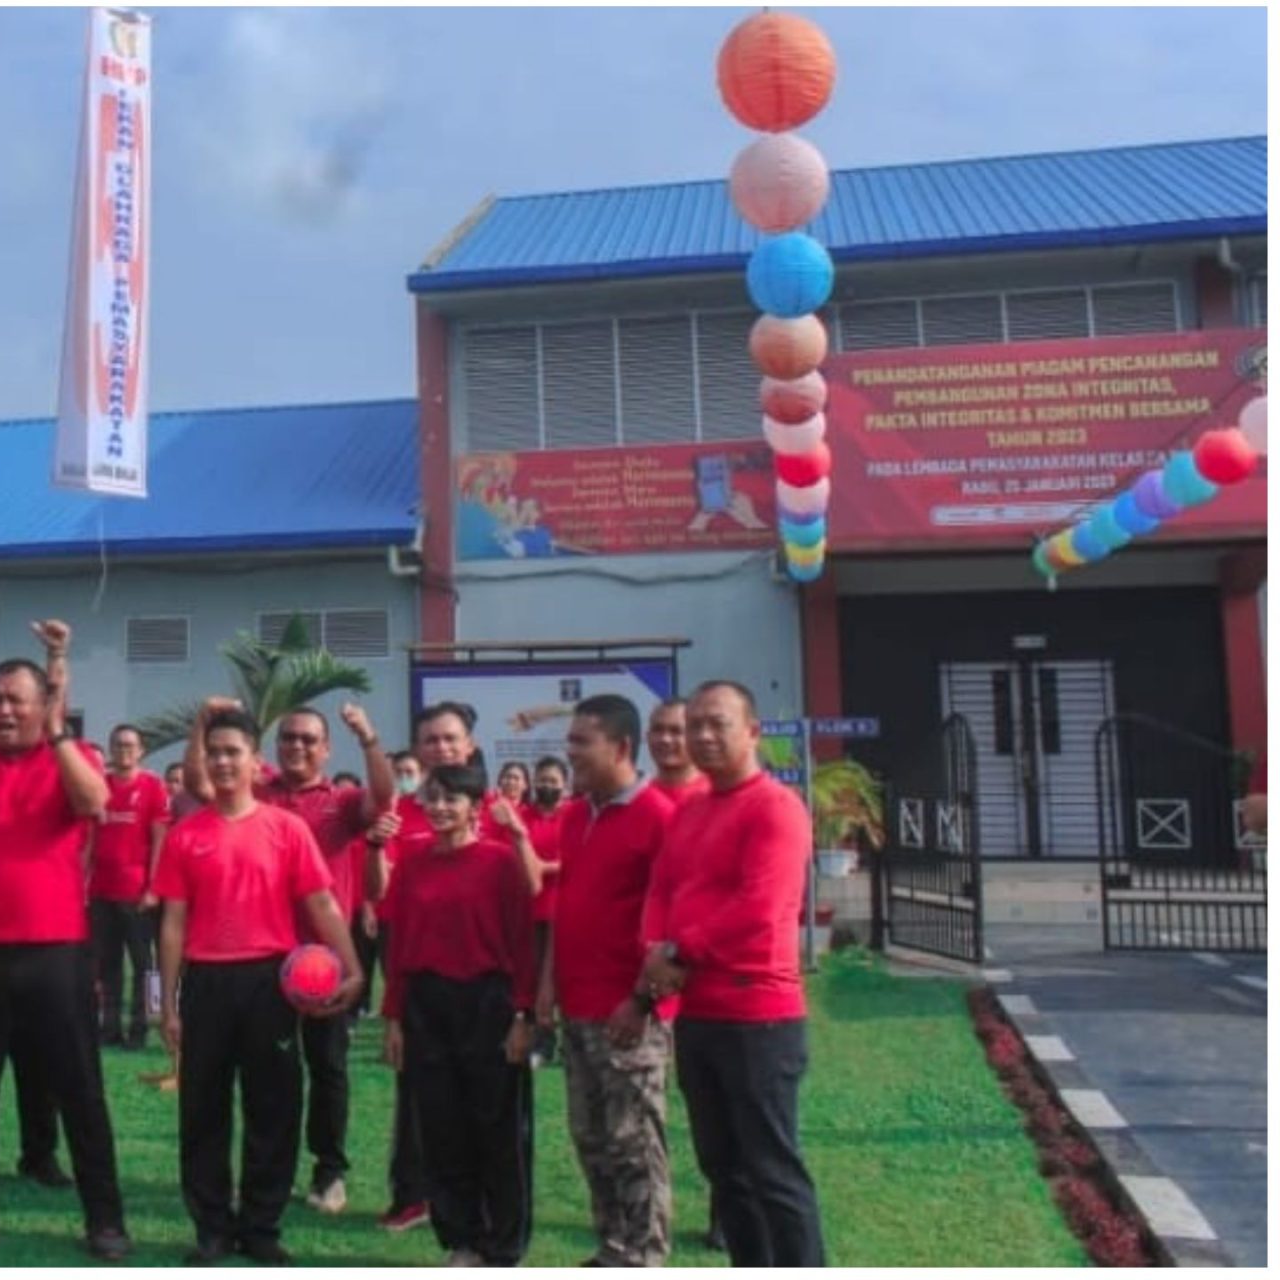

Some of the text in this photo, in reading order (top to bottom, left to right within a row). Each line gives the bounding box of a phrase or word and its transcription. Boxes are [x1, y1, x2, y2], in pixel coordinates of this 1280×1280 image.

[107, 277, 131, 458] PEMASYARAKATAN
[853, 350, 1219, 386] PENANDATANGANAN PIAGAM PENCANANGAN
[894, 376, 1178, 407] PEMBANGUNAN ZONA INTEGRITAS,
[864, 397, 1212, 431] PAKTA INTEGRITAS & KOMITMEN BERSAMA
[986, 427, 1088, 449] TAHUN 2023
[865, 461, 902, 478] PADA
[903, 458, 968, 475] LEMBAGA
[970, 453, 1097, 473] PEMASYARAKATAN
[1098, 450, 1145, 468] KELAS
[1023, 475, 1081, 492] JANUARI
